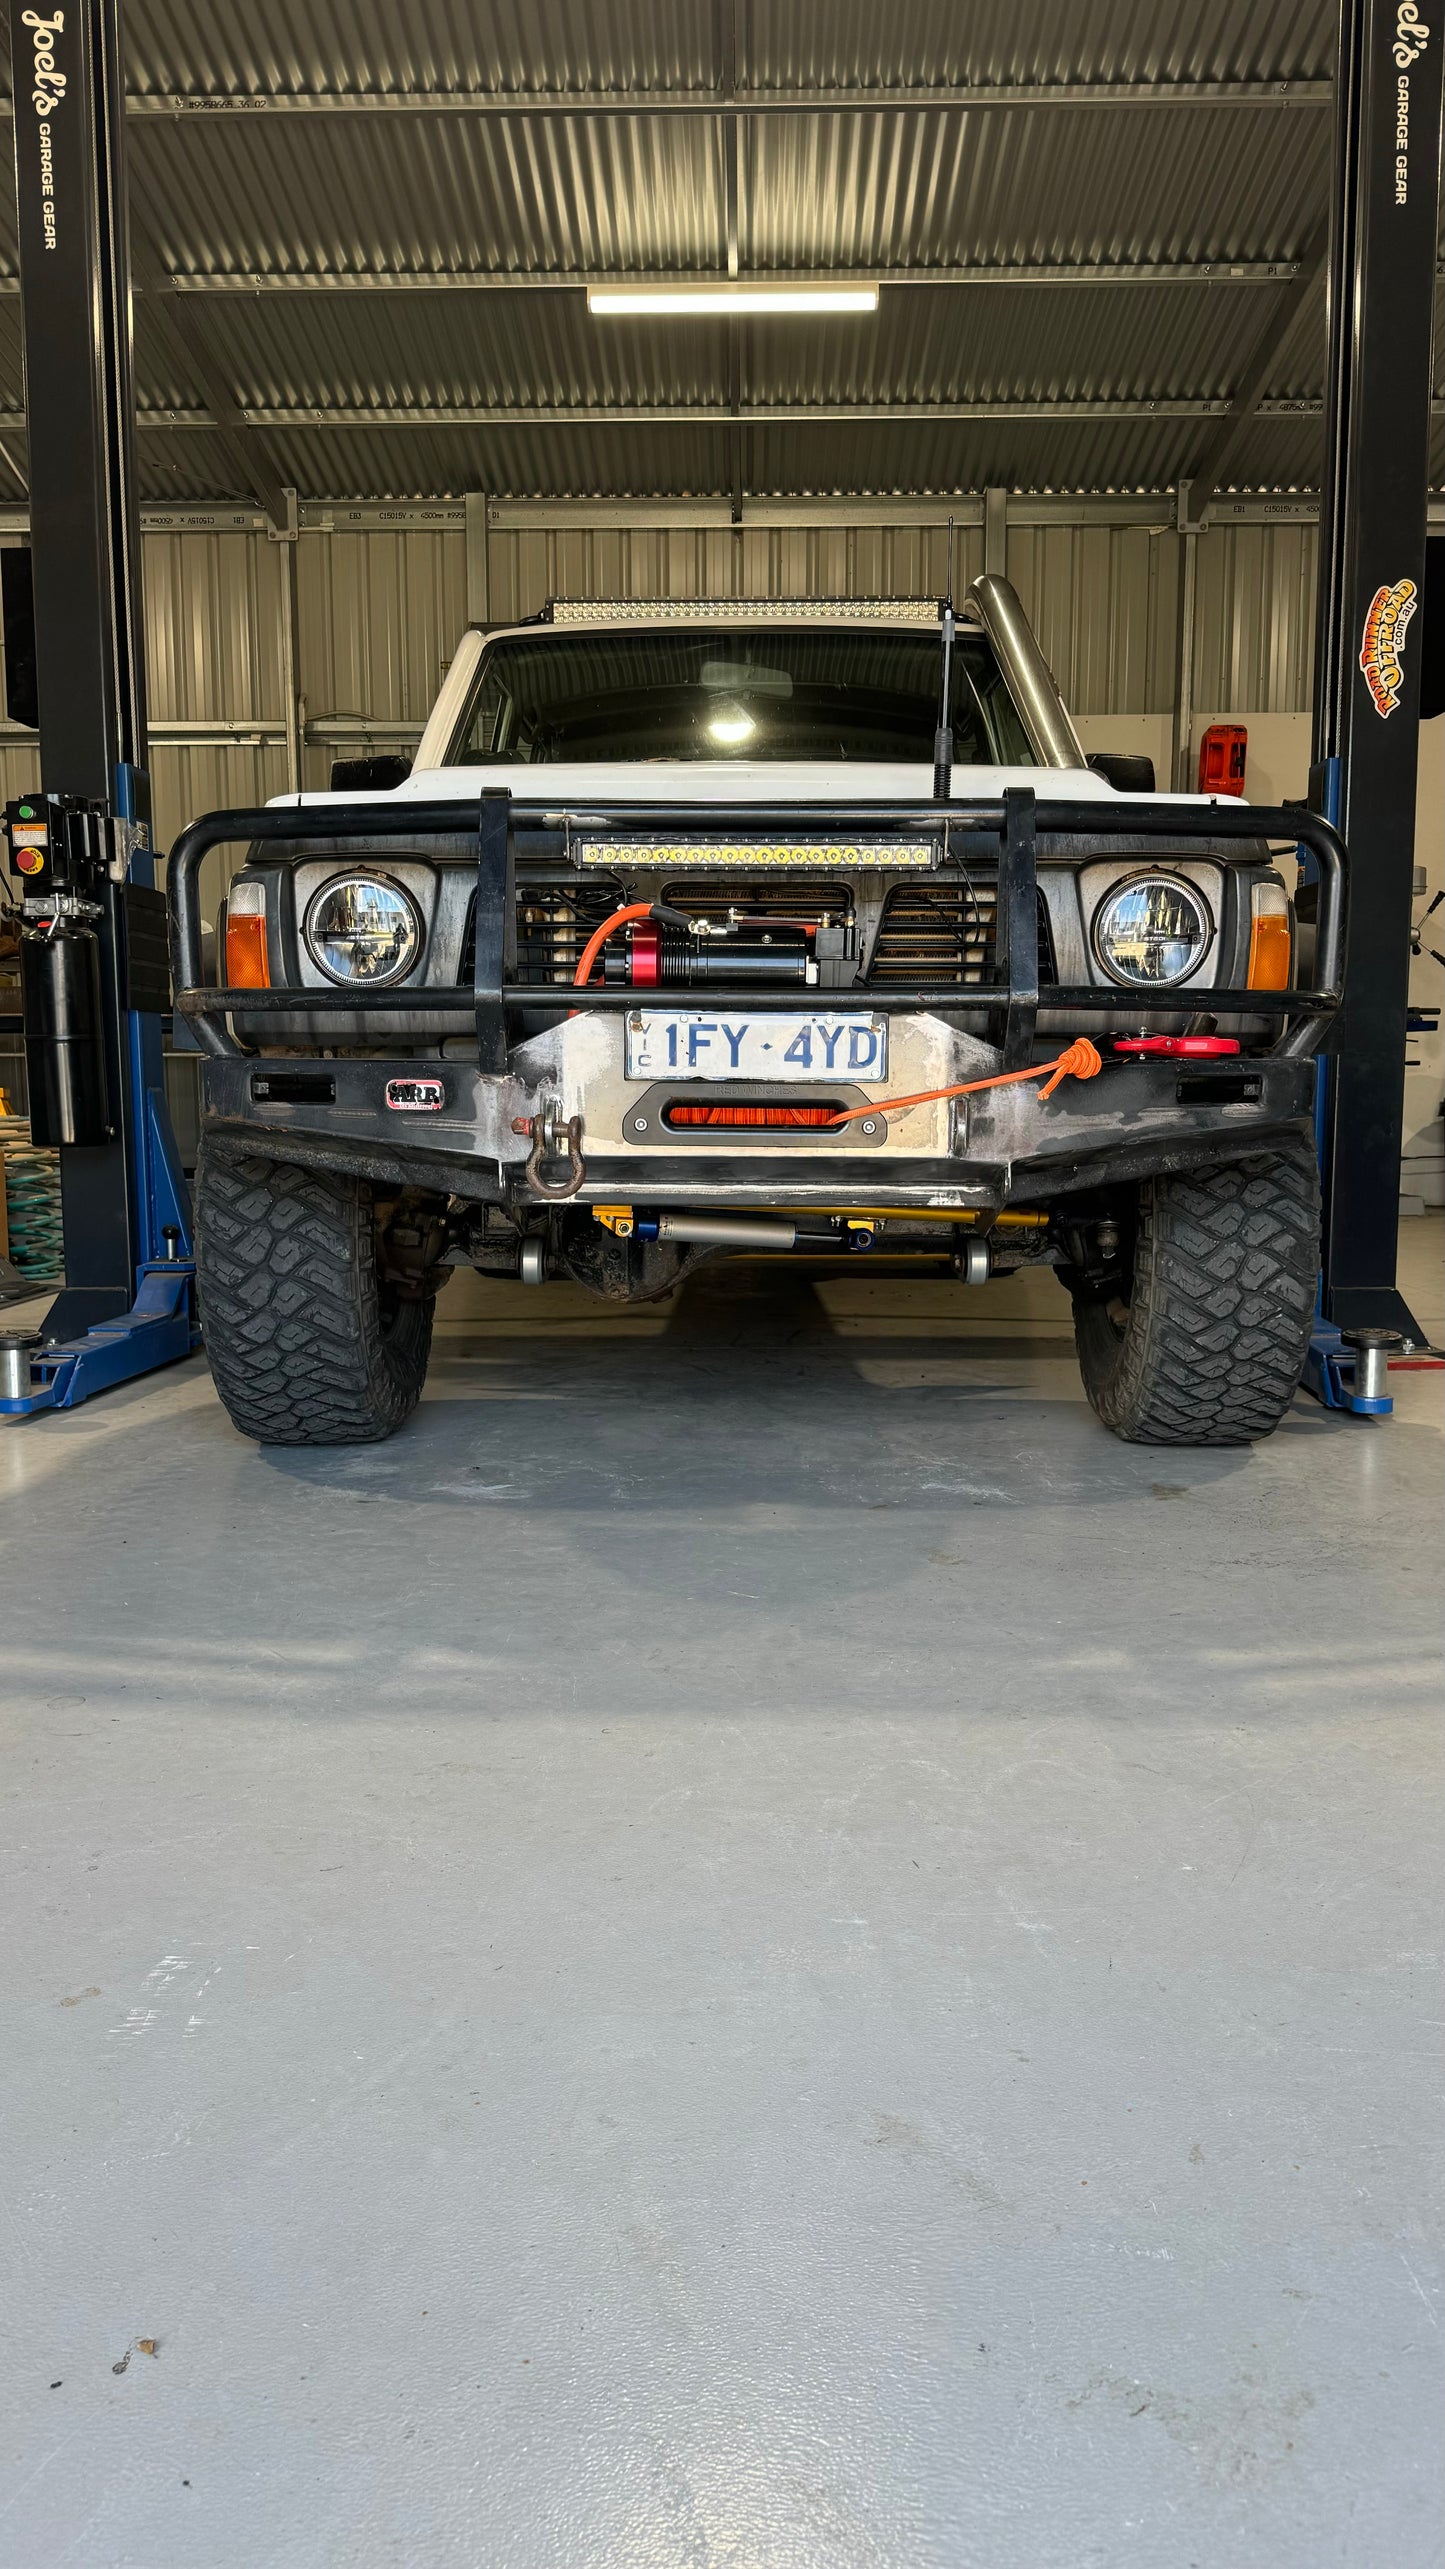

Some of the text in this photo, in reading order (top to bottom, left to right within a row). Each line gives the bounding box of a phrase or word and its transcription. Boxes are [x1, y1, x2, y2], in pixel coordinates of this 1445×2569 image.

[21, 9, 67, 116] Joel's
[39, 123, 56, 250] GARAGE GEAR
[1395, 75, 1410, 205] GARAGE GEAR
[1361, 586, 1398, 715] ROAD RUNNER
[1378, 581, 1415, 691] OFFROAD
[1394, 602, 1415, 649] .com.au
[665, 1023, 878, 1069] 1FY 4YD
[714, 1085, 799, 1096] RED WINCHES
